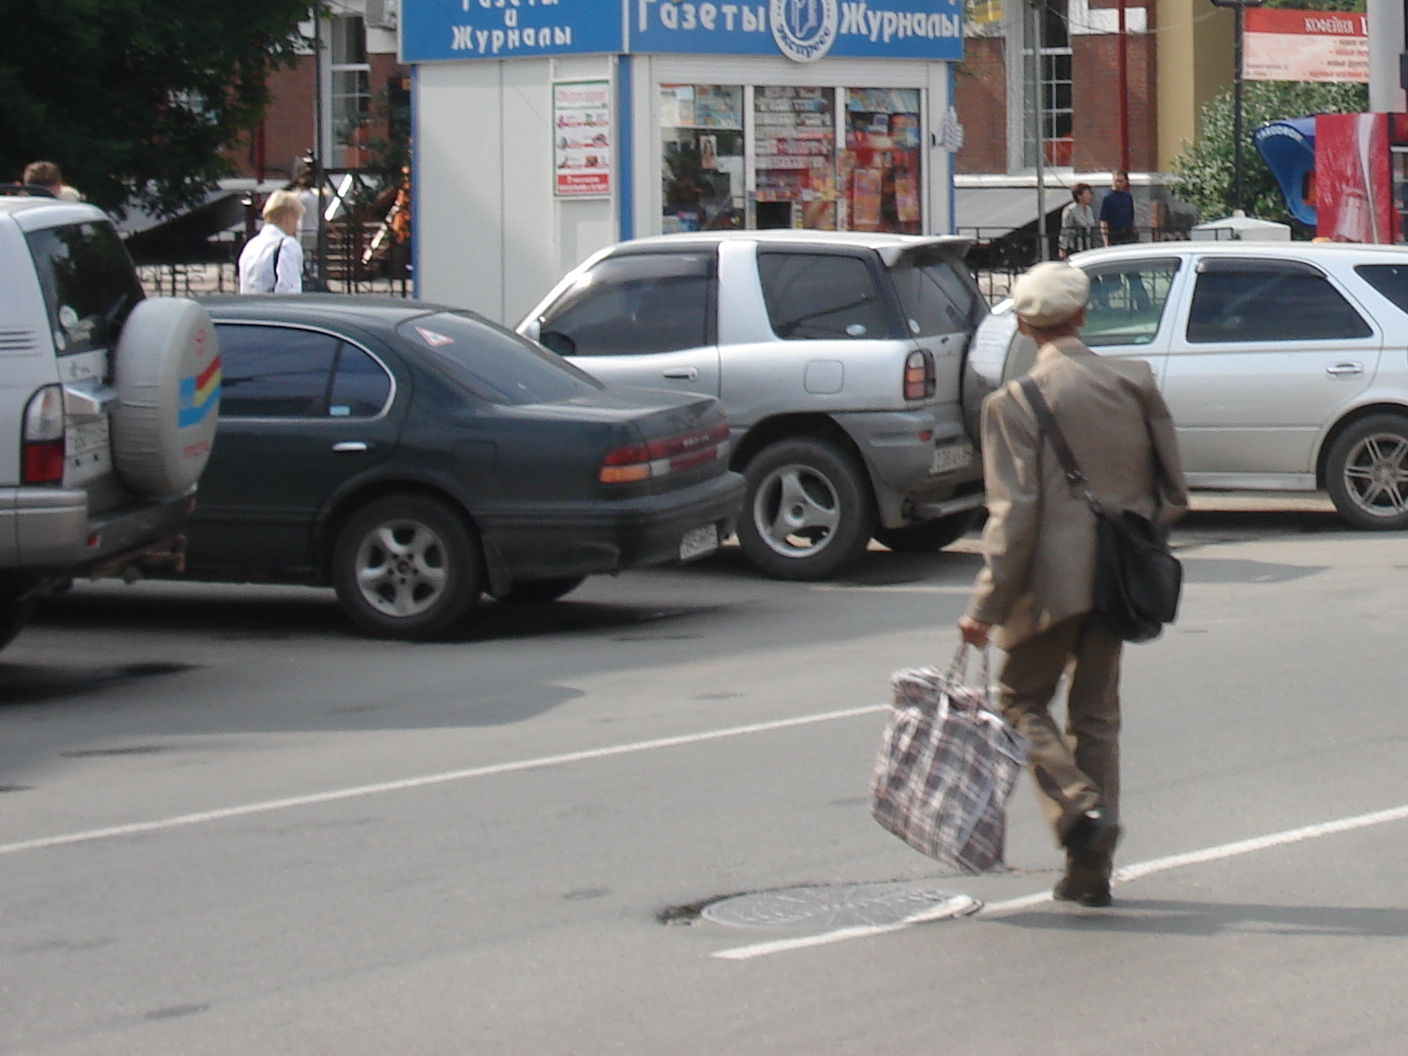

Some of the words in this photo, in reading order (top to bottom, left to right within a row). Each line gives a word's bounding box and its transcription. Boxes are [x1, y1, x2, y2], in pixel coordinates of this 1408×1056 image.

[504, 8, 518, 27] и
[839, 0, 962, 43] Журналы
[1304, 16, 1355, 34] КОФЕЙНЯ
[451, 25, 572, 54] Журналы
